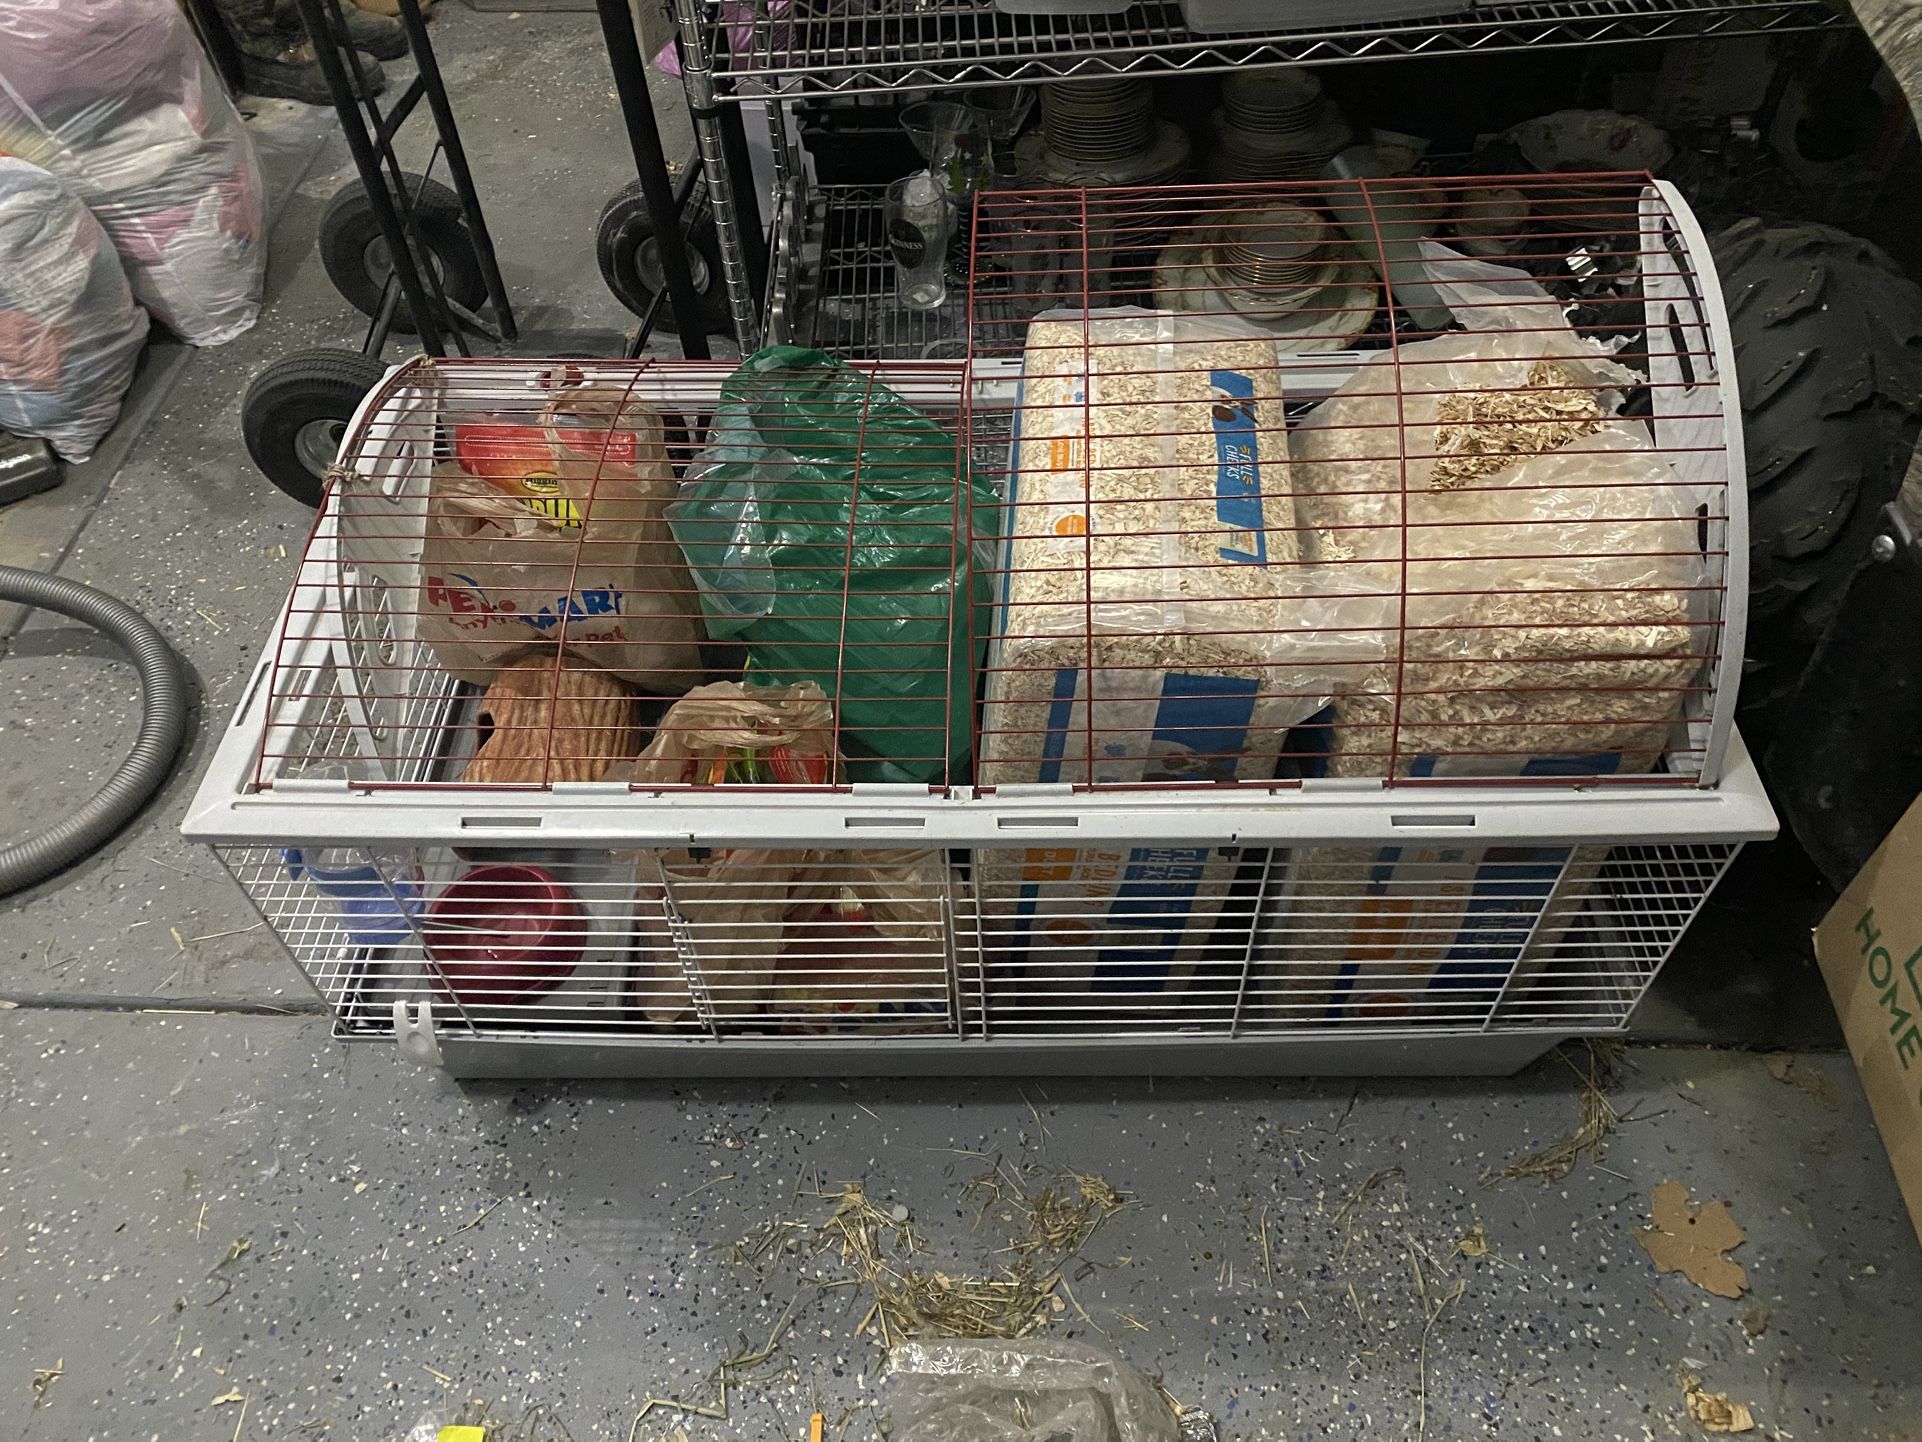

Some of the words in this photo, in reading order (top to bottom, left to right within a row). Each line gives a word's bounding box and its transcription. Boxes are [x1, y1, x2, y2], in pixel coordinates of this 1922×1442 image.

[1239, 453, 1254, 476] FULL
[1041, 850, 1057, 876] DUT
[1142, 848, 1172, 882] HEEK
[1167, 849, 1198, 879] FULL
[1083, 853, 1121, 907] BDING
[1855, 906, 1922, 1070] HOME
